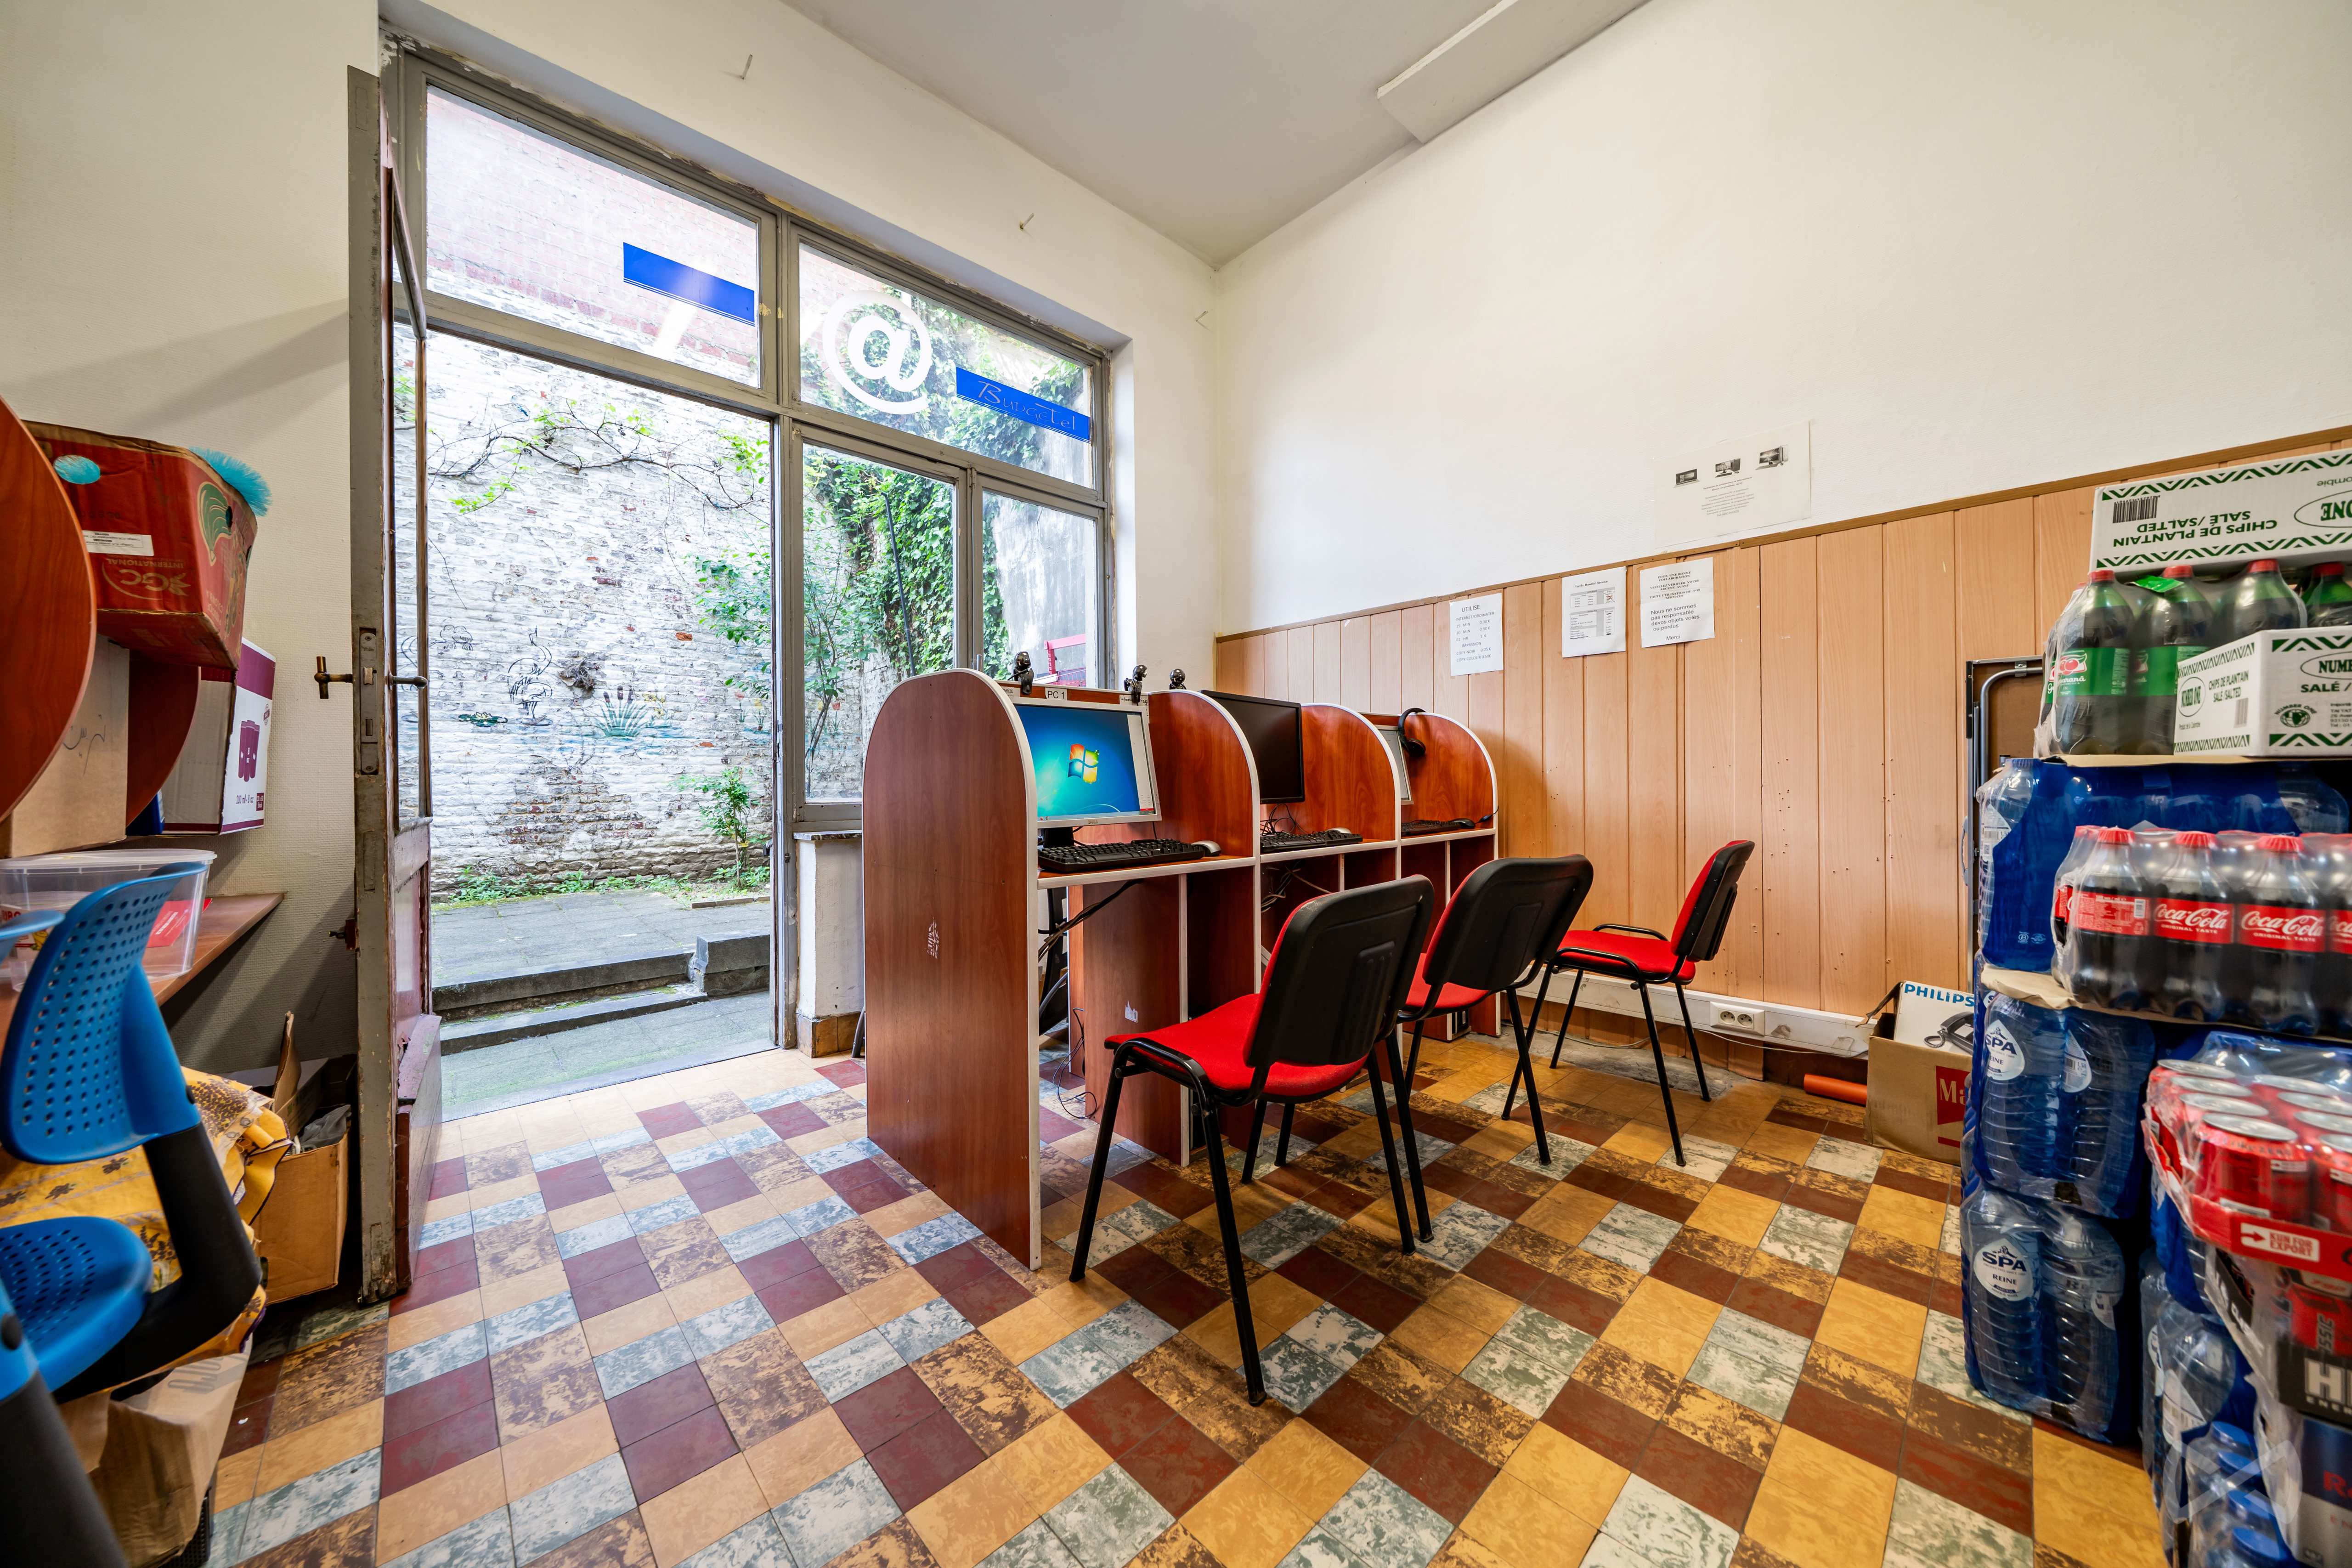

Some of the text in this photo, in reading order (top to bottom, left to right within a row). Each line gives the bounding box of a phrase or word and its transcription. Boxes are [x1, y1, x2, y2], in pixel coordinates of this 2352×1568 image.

[823, 289, 932, 415] @
[2210, 511, 2251, 526] SALÉ
[2113, 520, 2278, 547] CHIPS DE PLANTAIN
[106, 558, 183, 568] INTERNATIONAL
[119, 569, 169, 591] GC
[1662, 610, 1694, 618] responsable
[2227, 670, 2249, 686] PLANTAIN
[2301, 681, 2340, 693] SALÉ
[1047, 691, 1059, 699] PC
[2274, 704, 2302, 715] NUMBER
[2154, 904, 2230, 929] Coca-Cola
[2241, 911, 2324, 936] Coca-Cola
[1904, 984, 1975, 1007] PHILIPS
[1985, 1035, 2017, 1055] SPA
[1982, 1251, 2027, 1272] SPA
[1992, 1274, 2017, 1285] REINE
